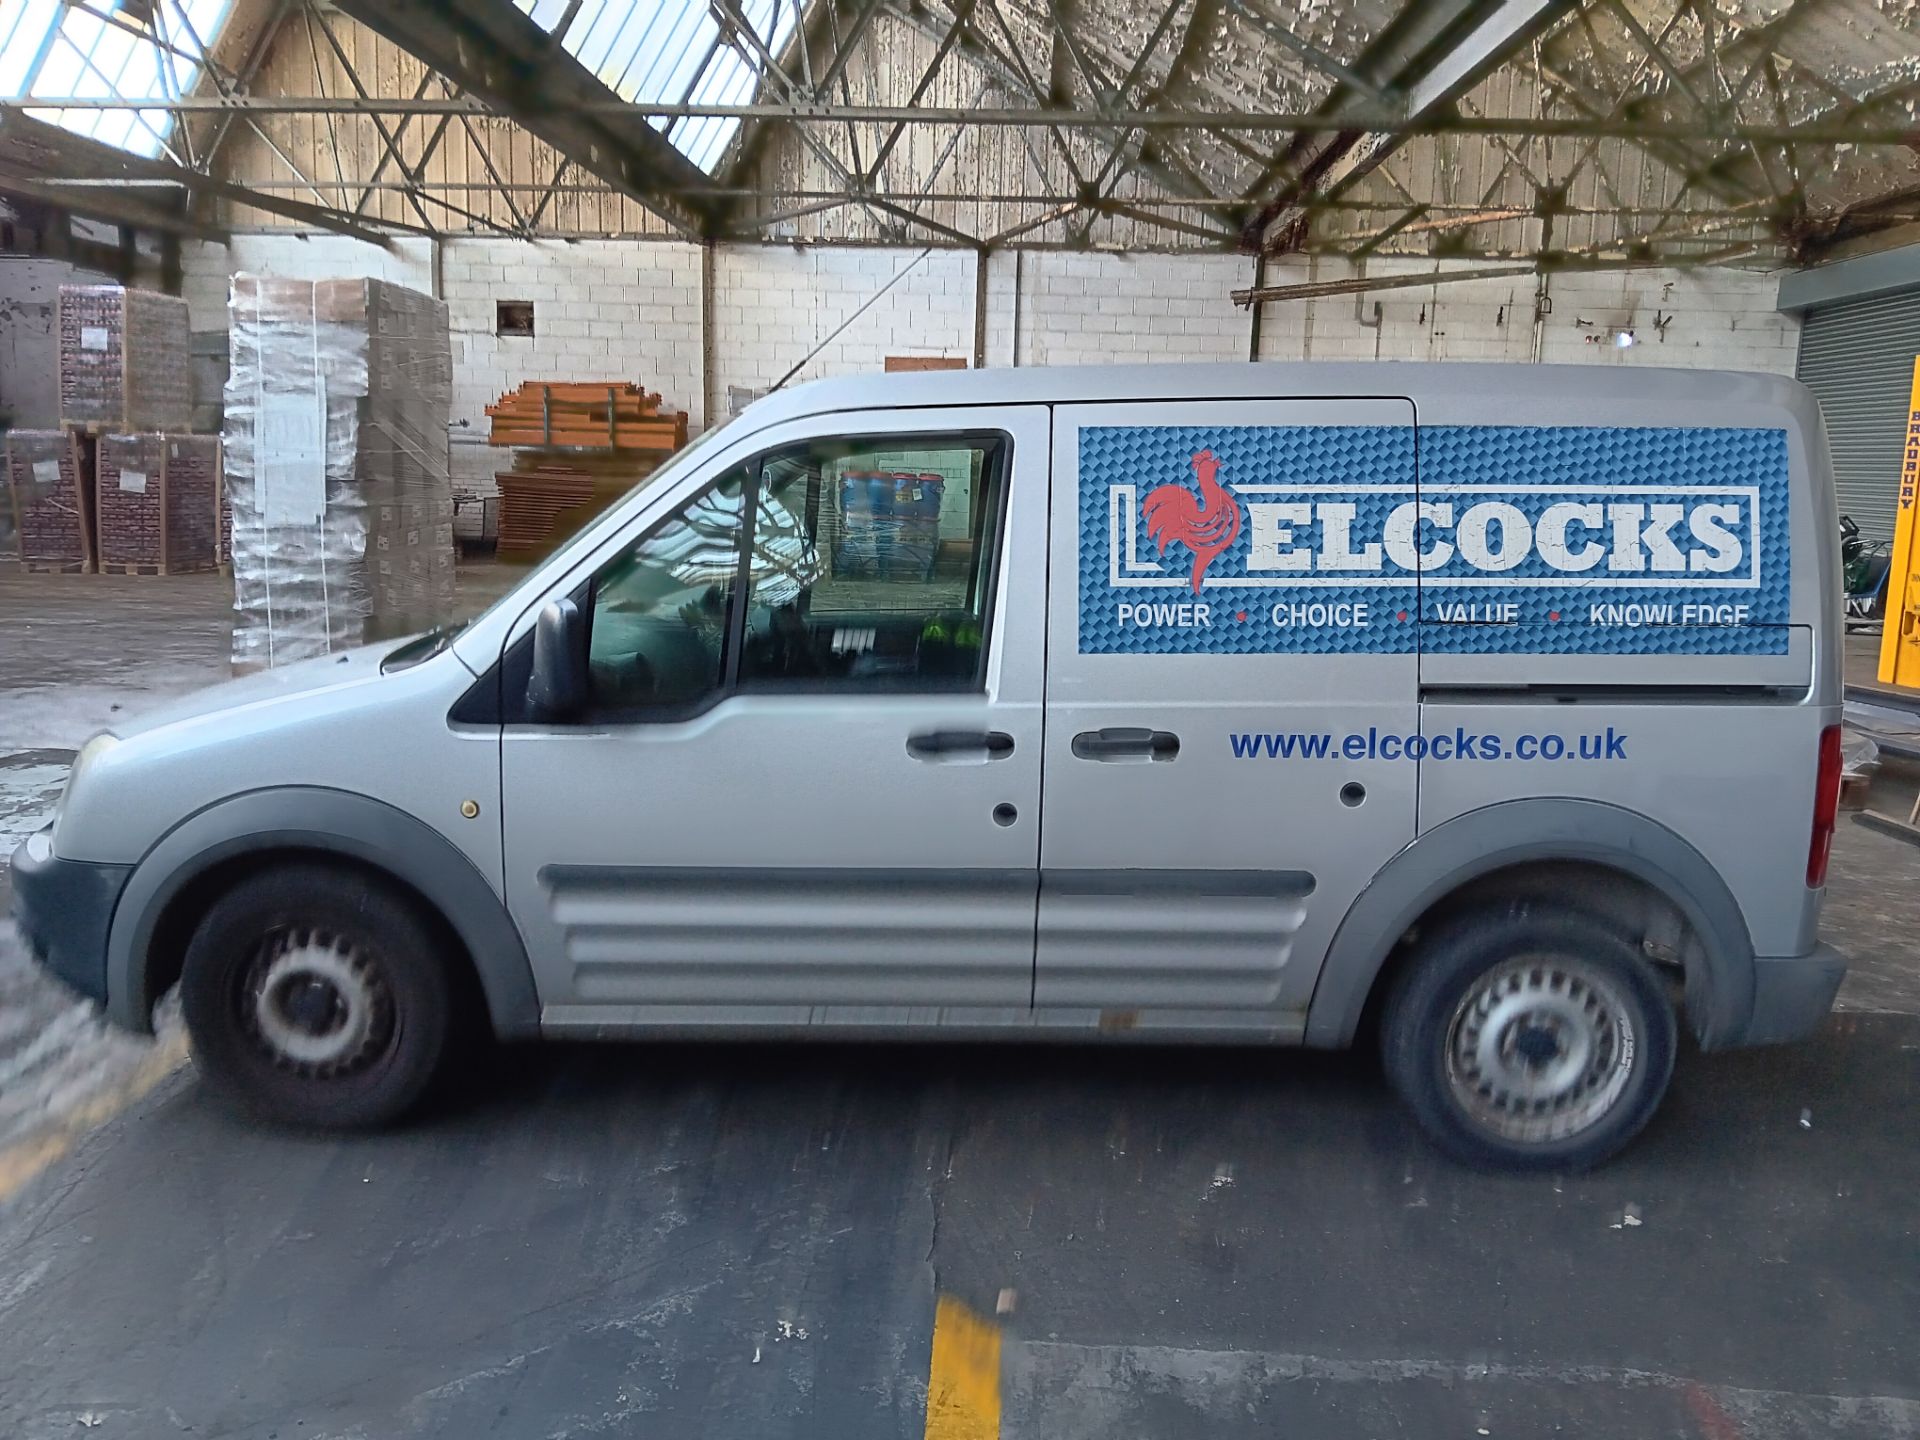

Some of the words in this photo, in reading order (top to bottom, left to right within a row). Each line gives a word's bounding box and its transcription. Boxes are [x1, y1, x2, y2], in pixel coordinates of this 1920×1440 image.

[1900, 411, 1920, 509] BRADBURY
[1246, 501, 1743, 572] ELCOCKS
[1118, 603, 1211, 627] POWER
[1271, 603, 1369, 627] CHOICE
[1436, 603, 1519, 627] VALUE
[1590, 603, 1750, 628] KNOWLEDGE
[1229, 727, 1628, 760] www.elcocks.co.uk
